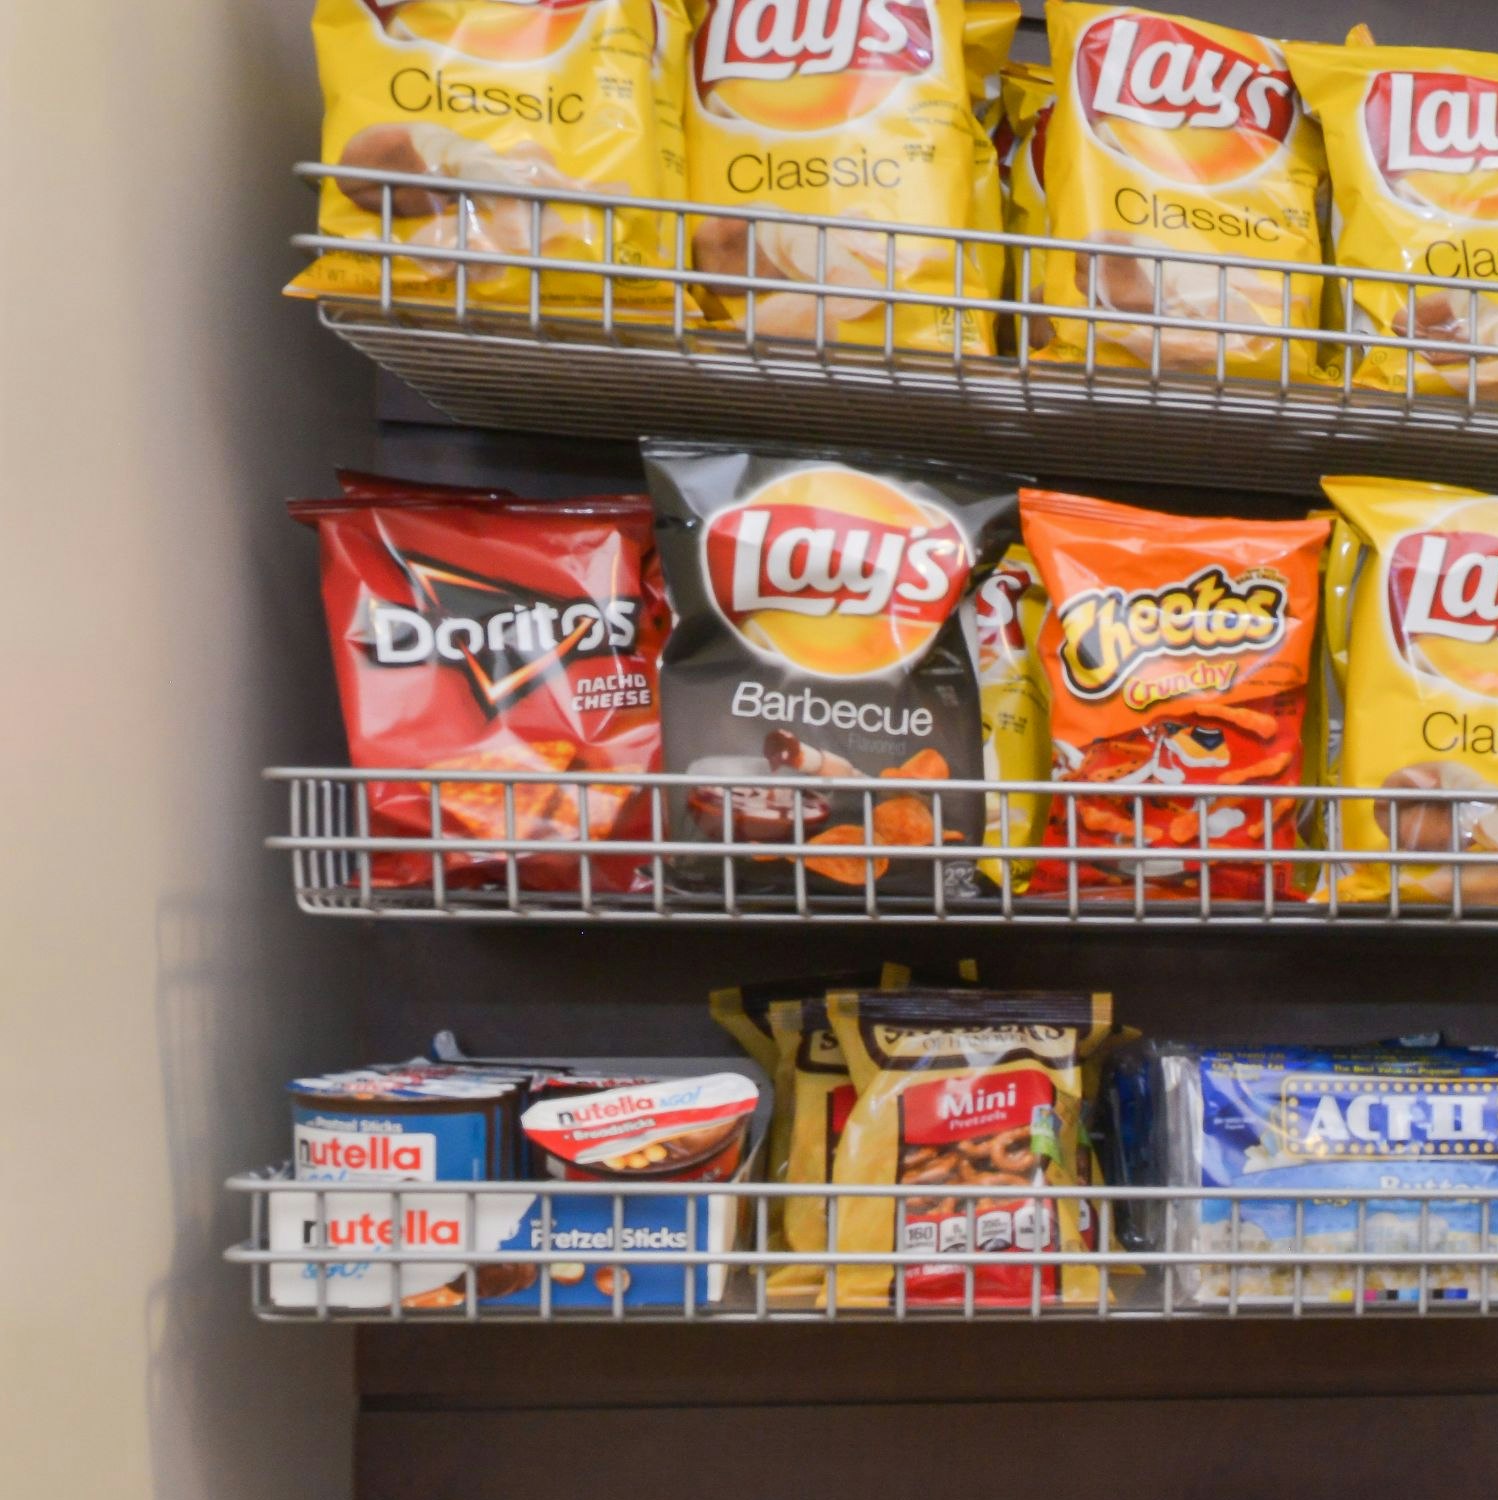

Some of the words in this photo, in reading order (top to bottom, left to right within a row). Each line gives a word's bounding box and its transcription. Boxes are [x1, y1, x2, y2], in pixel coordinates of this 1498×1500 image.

[702, 0, 909, 82] Lays
[389, 67, 584, 125] Classic
[1092, 21, 1293, 131] Lay's
[727, 149, 900, 193] Classic
[1114, 186, 1280, 243] Classic
[733, 510, 958, 615] Lay's
[377, 600, 635, 664] Doritos
[1063, 576, 1283, 685] Cheetos
[571, 689, 651, 711] CHEESE
[576, 672, 647, 694] NACHO
[1127, 660, 1237, 704] Crunchy
[732, 682, 934, 736] Barbecue
[558, 1096, 654, 1127] nutella
[939, 1084, 1016, 1119] Mini
[949, 1111, 1007, 1131] Pretzels
[573, 1117, 656, 1141] Breadsticks
[300, 1136, 422, 1170] nutella
[621, 1227, 687, 1248] Sticks
